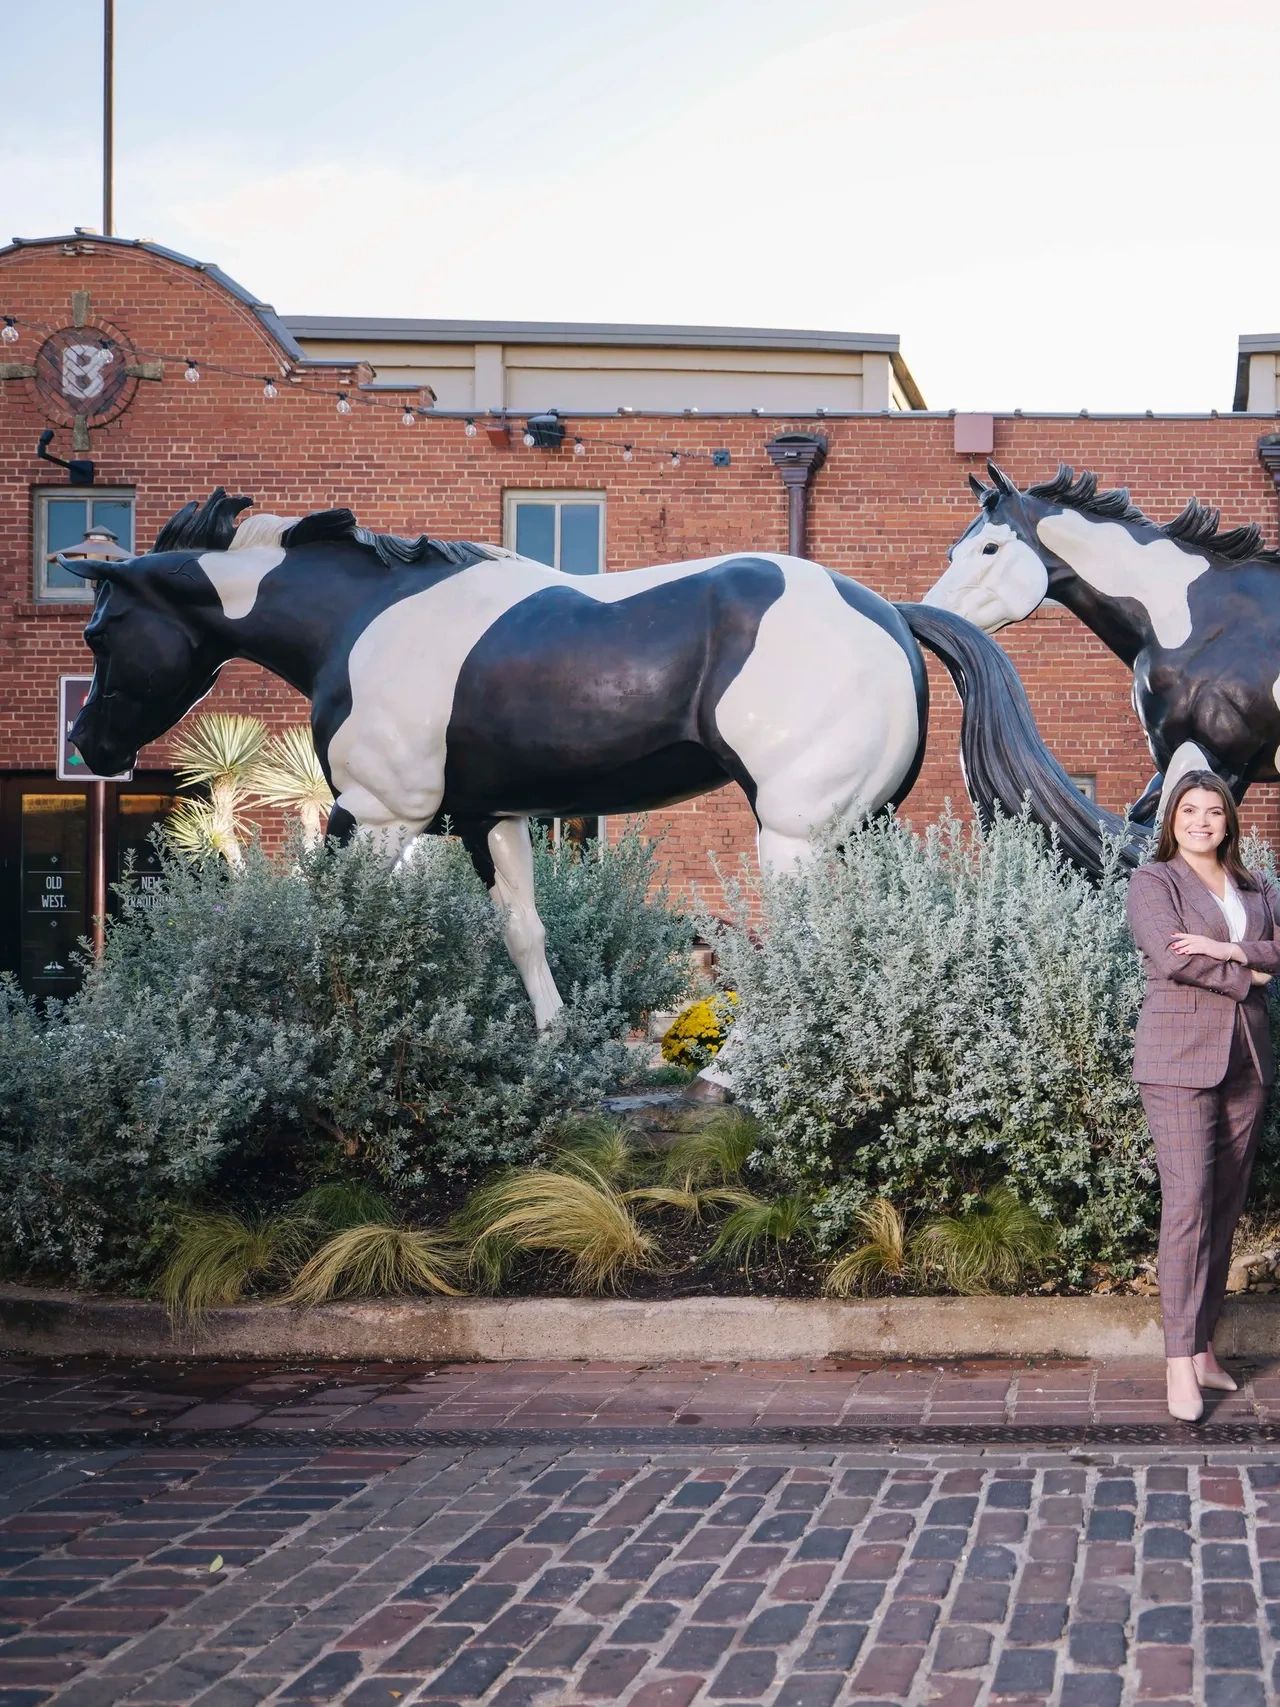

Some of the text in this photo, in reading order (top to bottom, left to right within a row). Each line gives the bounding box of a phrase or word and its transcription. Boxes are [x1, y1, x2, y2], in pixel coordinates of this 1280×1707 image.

[62, 344, 105, 399] B
[46, 876, 63, 889] OLD
[41, 895, 67, 908] WEST.
